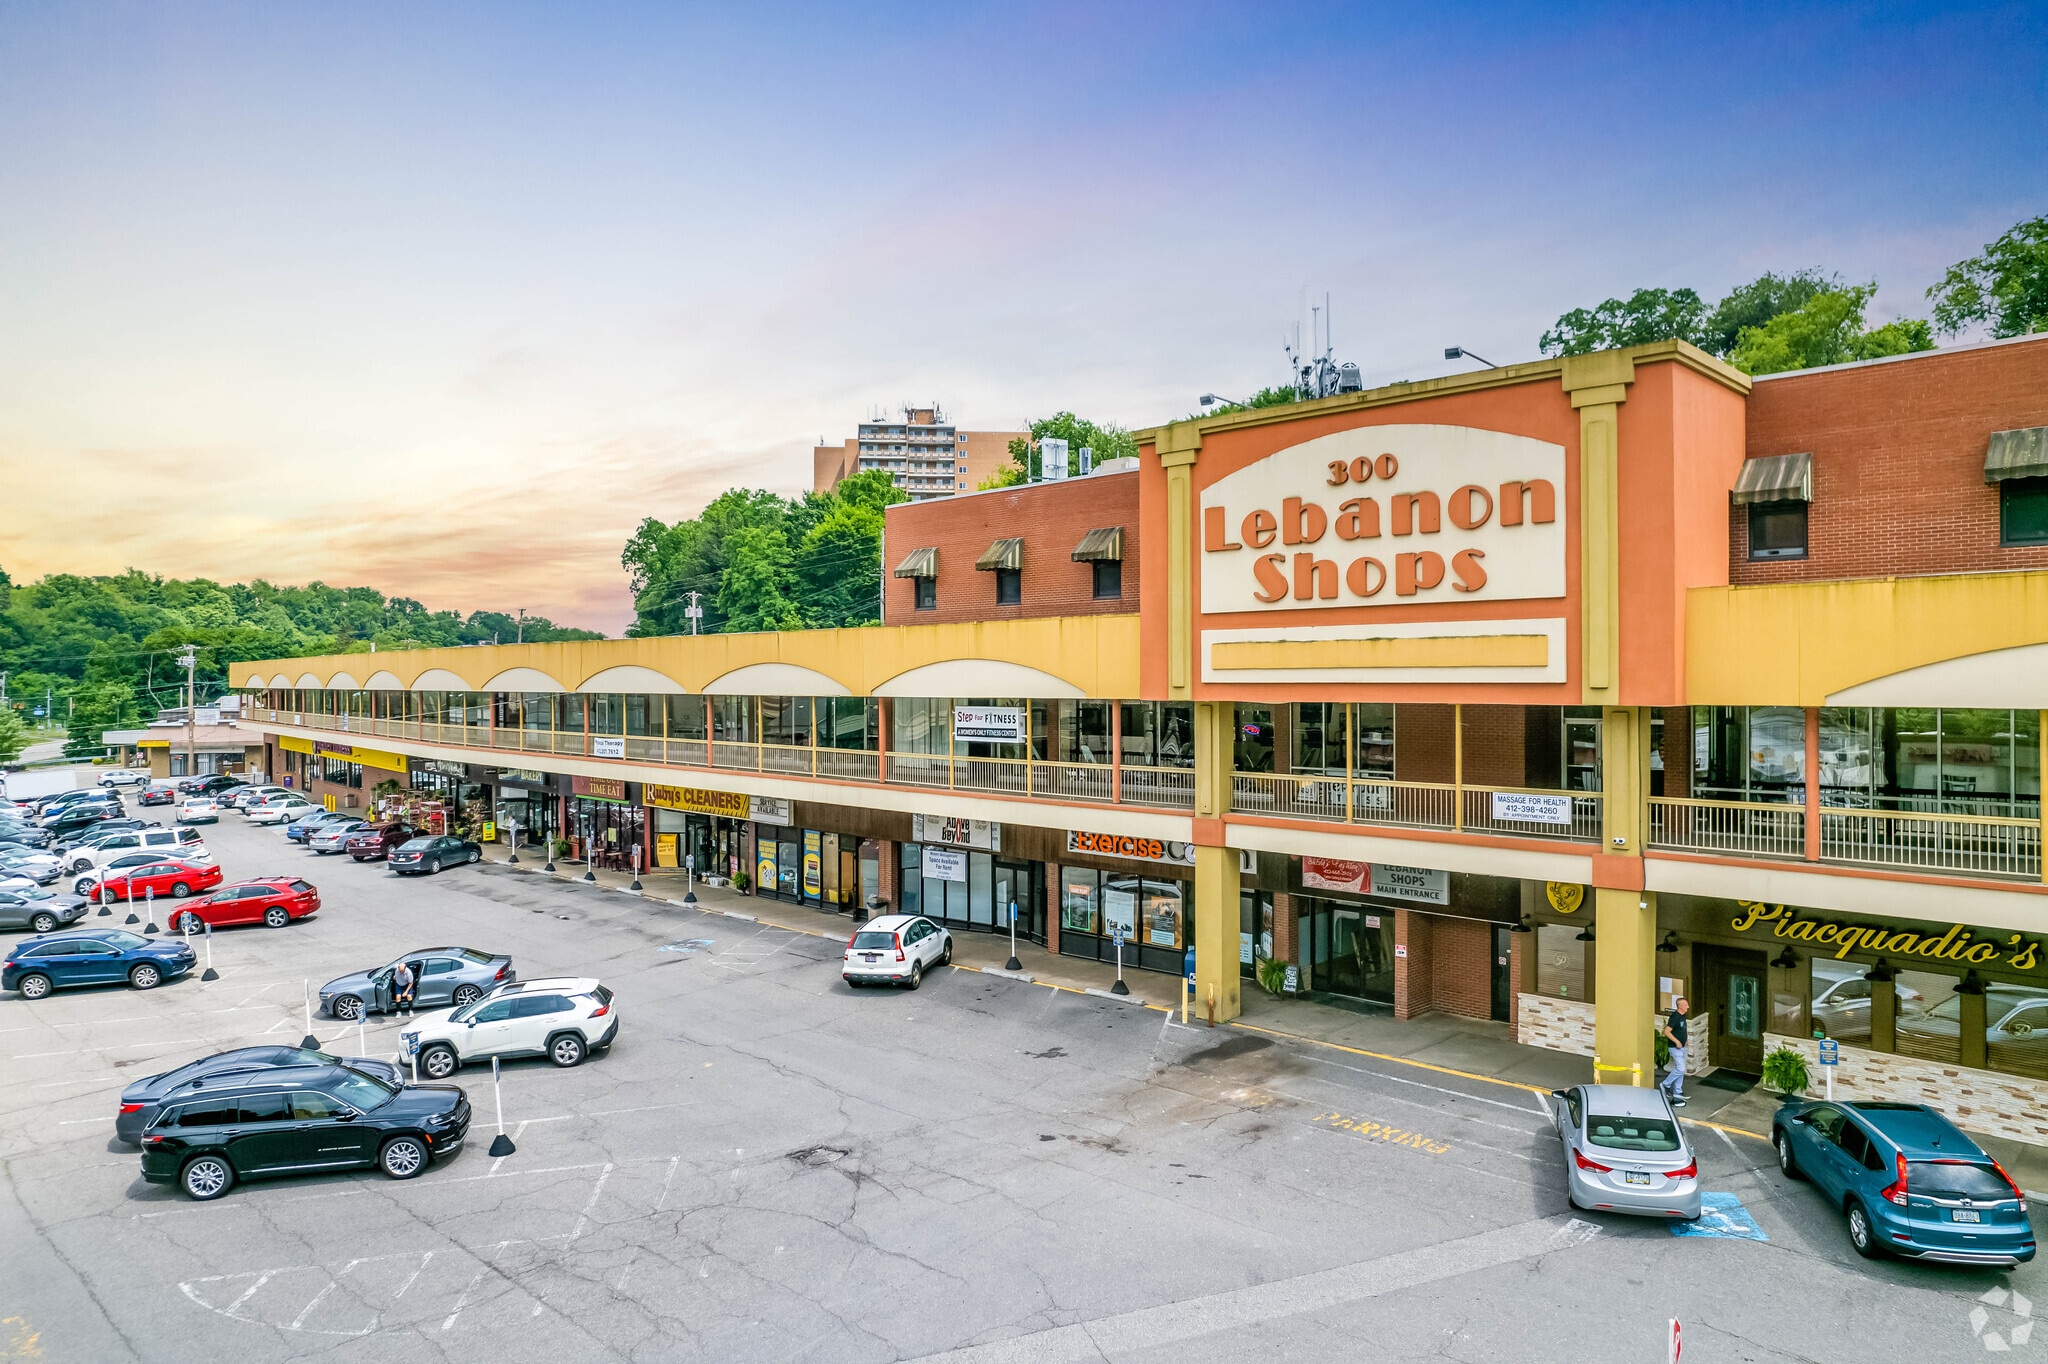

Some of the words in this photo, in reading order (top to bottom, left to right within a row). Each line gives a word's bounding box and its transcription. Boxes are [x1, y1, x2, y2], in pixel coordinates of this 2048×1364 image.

[1326, 452, 1399, 487] 300
[1204, 478, 1556, 553] Lebanon
[1253, 547, 1488, 603] Shops
[957, 711, 973, 722] Step
[984, 712, 1017, 725] FITNESS
[987, 729, 1001, 737] FITNESS
[605, 740, 623, 748] Therapy
[589, 783, 607, 795] TIME
[607, 785, 622, 797] EAT
[647, 784, 681, 806] Ruby's
[684, 789, 741, 811] CLEANERS
[1497, 796, 1527, 805] MASSAGE
[1543, 799, 1567, 807] HEALTH
[1505, 804, 1558, 815] 412-398-4260
[1077, 830, 1164, 860] Exercise
[941, 858, 959, 866] Available
[1391, 874, 1426, 887] SHOPS
[1377, 885, 1397, 895] MAIN
[1399, 889, 1440, 900] ENTRANCE
[1731, 898, 2039, 970] Piacquadio's
[1311, 1111, 1453, 1155] PARKING
